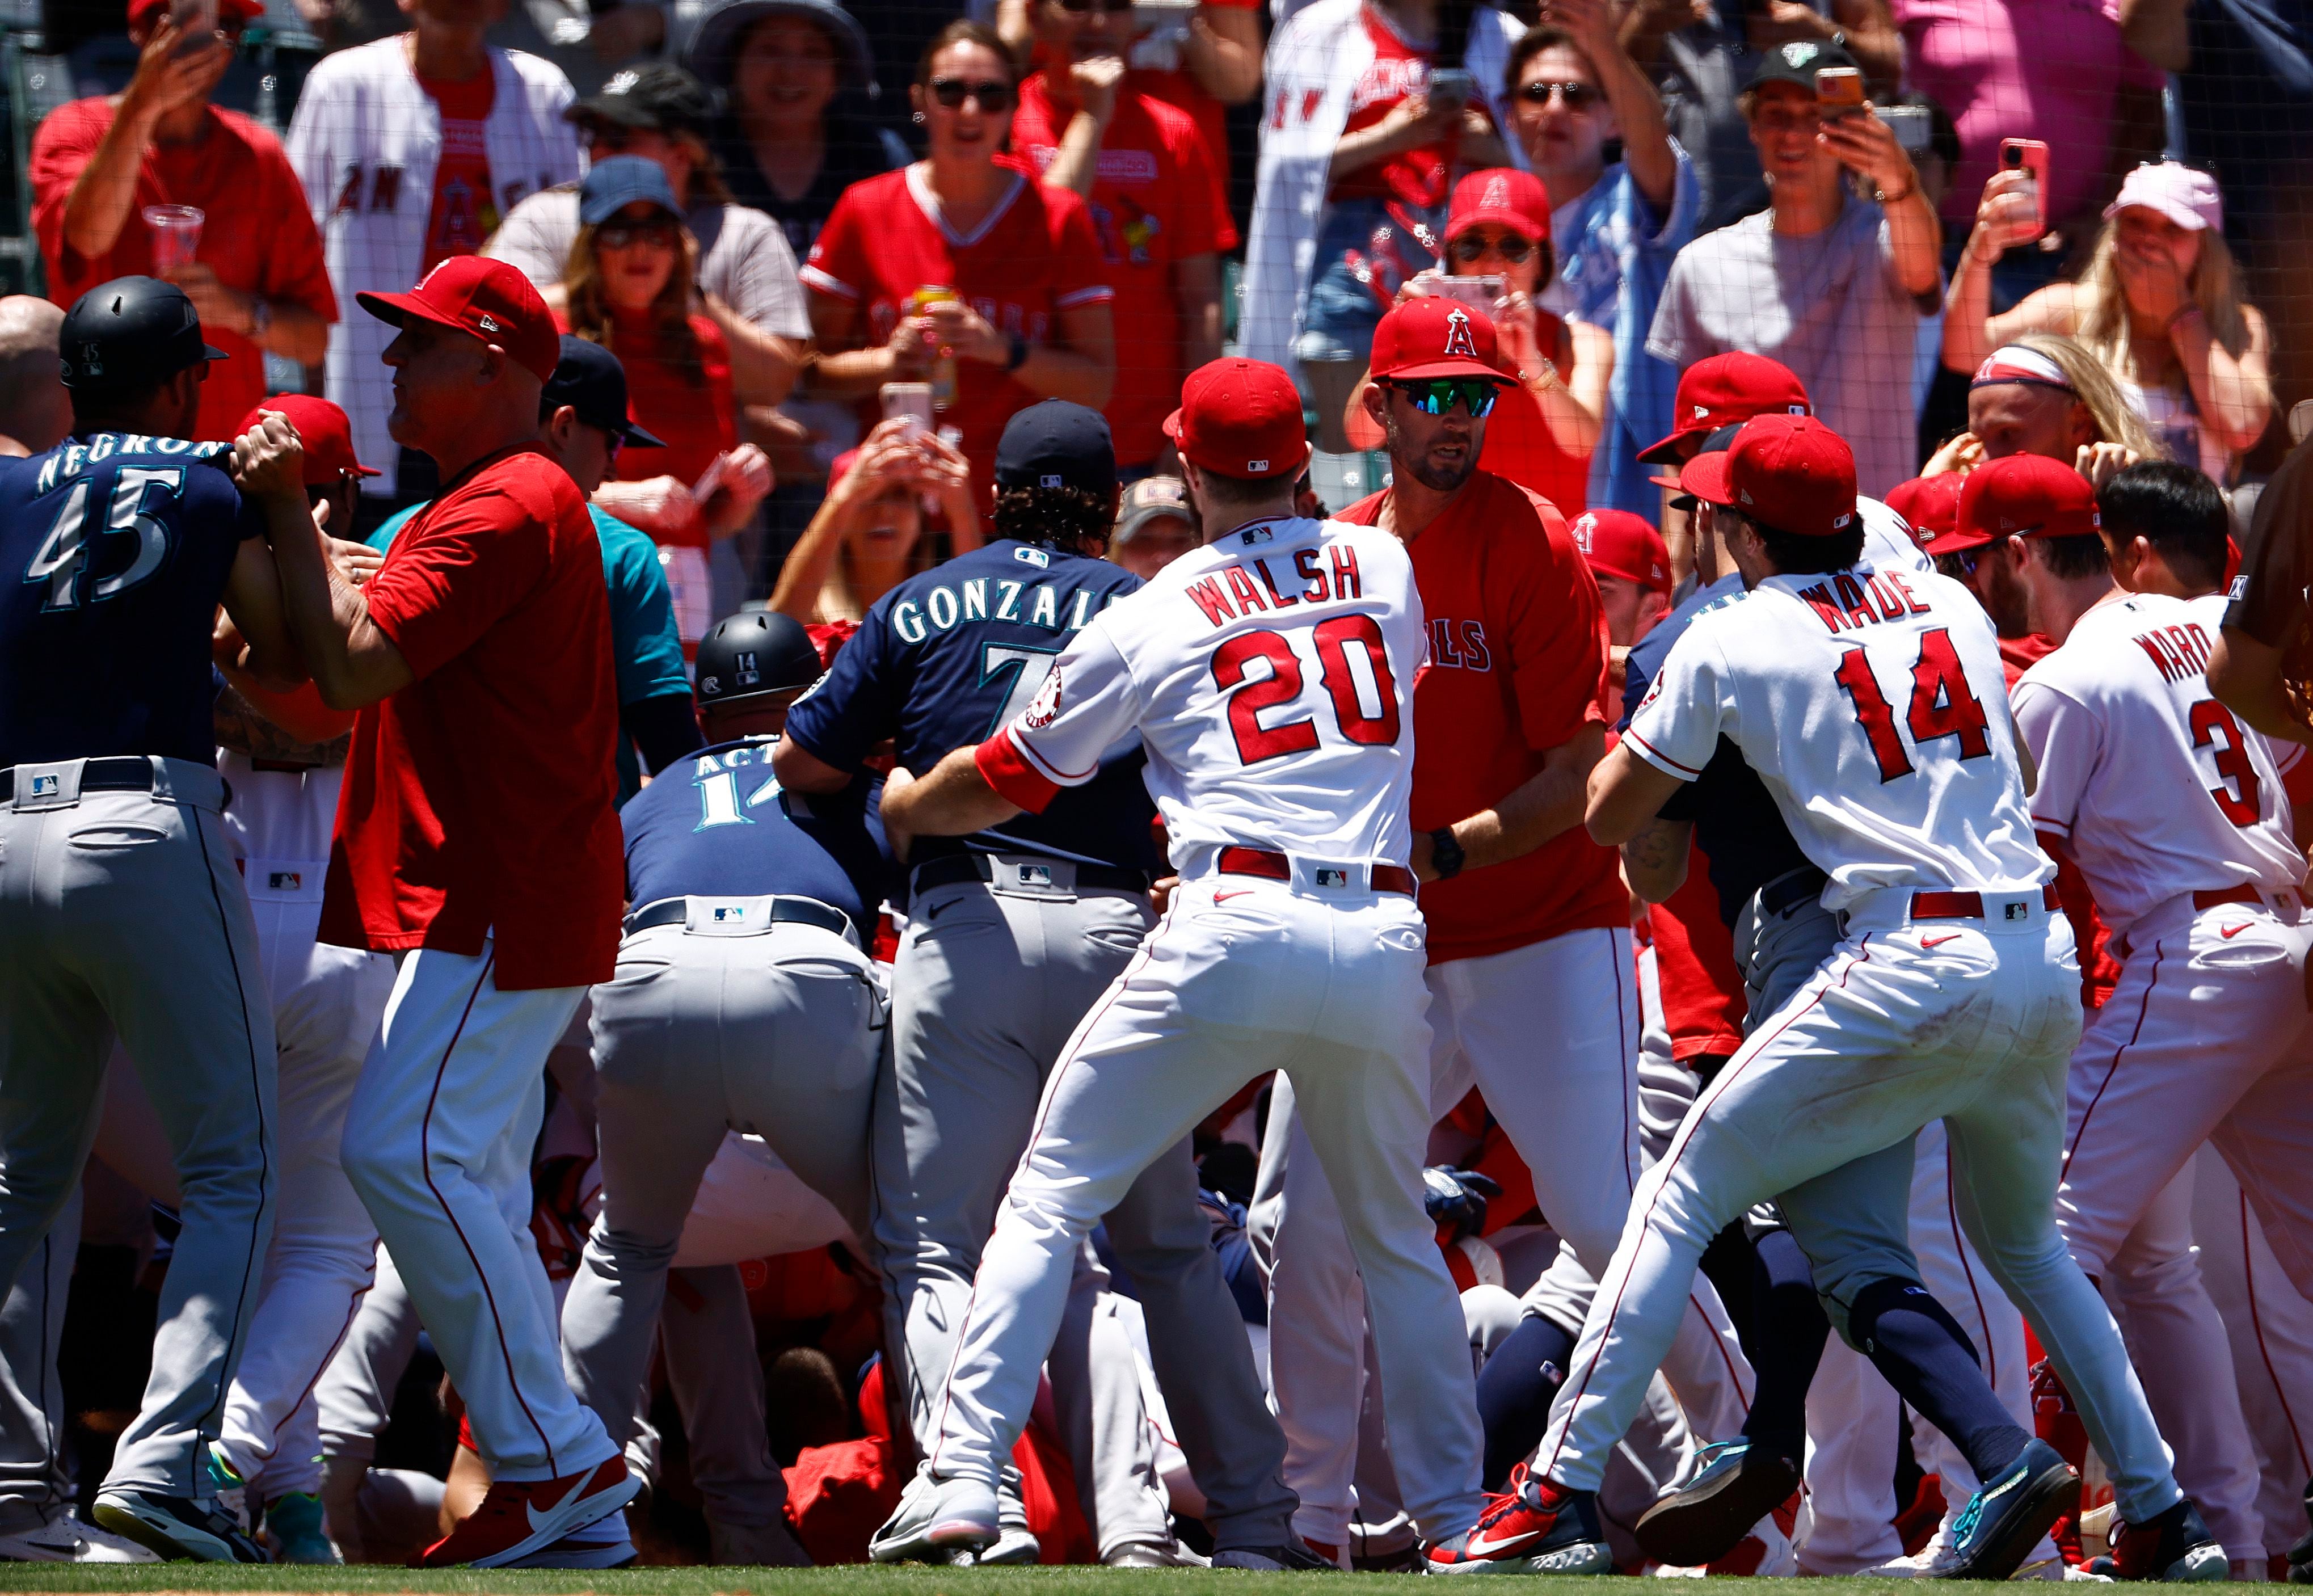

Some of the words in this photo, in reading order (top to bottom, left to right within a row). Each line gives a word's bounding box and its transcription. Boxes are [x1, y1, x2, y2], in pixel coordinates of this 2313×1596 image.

[82, 342, 100, 361] 45
[1444, 308, 1478, 356] A
[34, 432, 233, 497] NEGRON
[22, 464, 187, 614] 45
[1572, 512, 1598, 555] A
[893, 577, 1126, 646] GONZAL
[1185, 545, 1362, 628] WALSH
[1797, 570, 1932, 634] WADE
[737, 652, 757, 672] 14
[978, 641, 1064, 743] 7
[1210, 612, 1400, 767] 20
[1833, 627, 1992, 784] 14
[2189, 698, 2261, 828] 3
